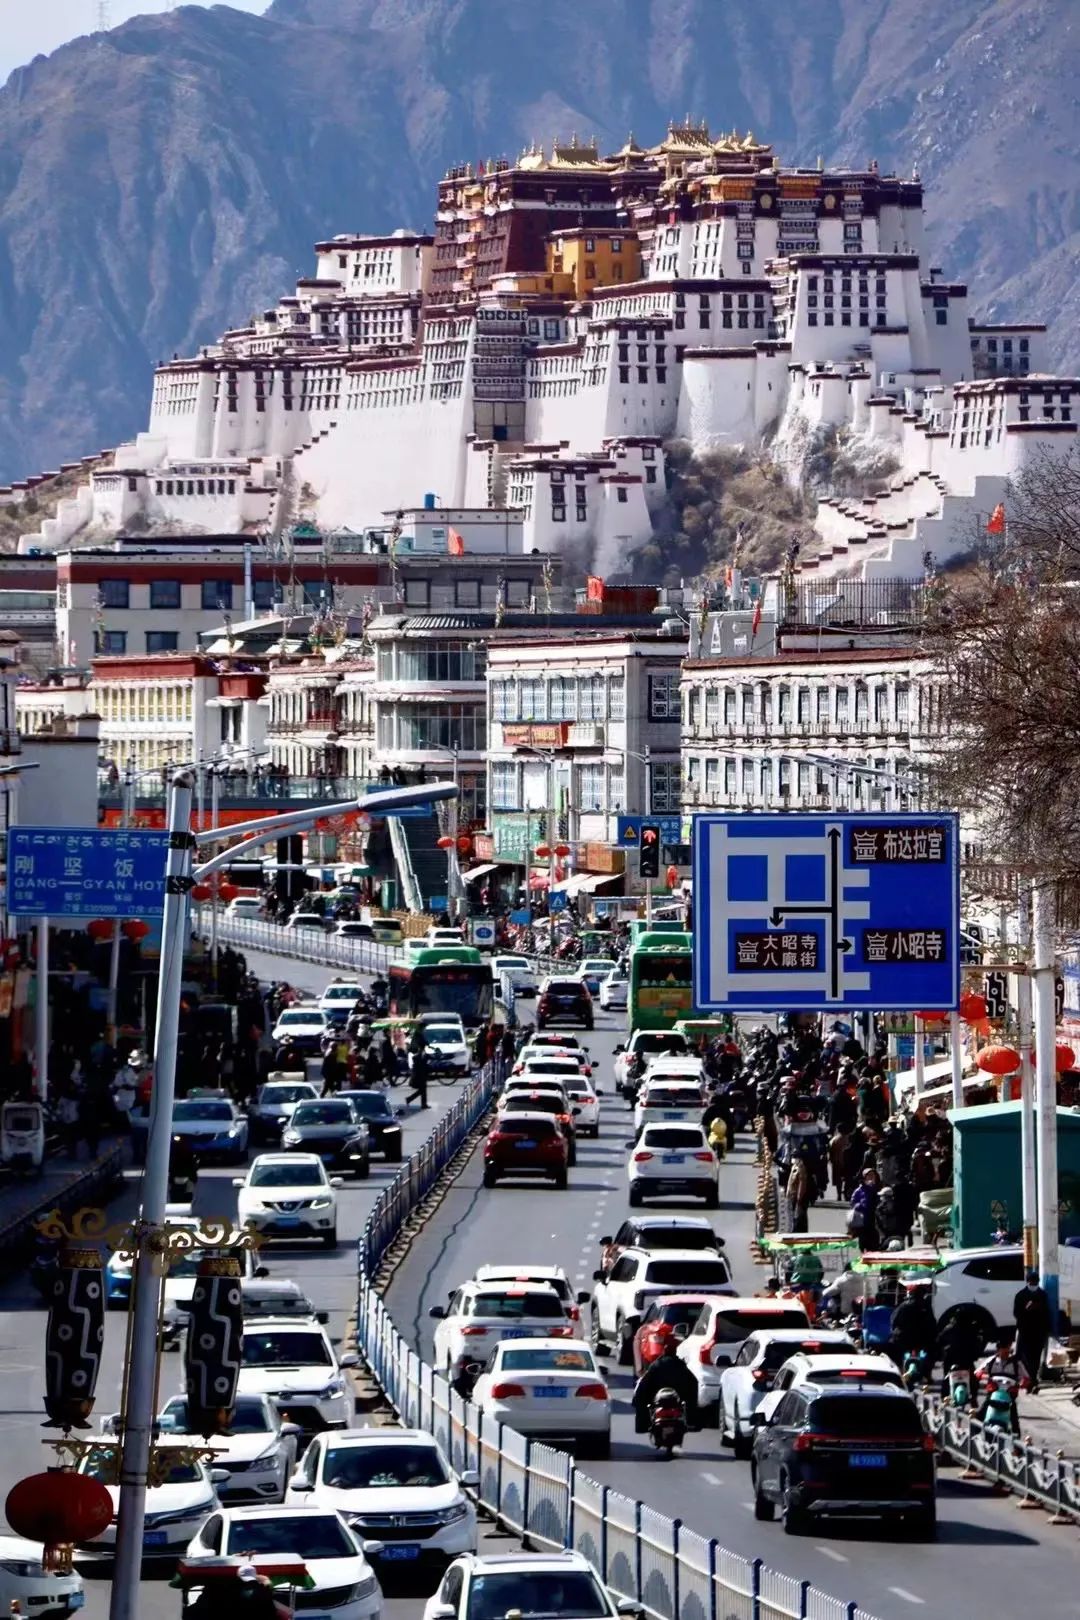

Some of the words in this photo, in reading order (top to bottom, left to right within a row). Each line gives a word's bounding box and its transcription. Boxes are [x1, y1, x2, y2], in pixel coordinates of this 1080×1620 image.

[883, 830, 942, 860] 布达拉宫
[763, 934, 816, 950] 大昭寺
[891, 931, 942, 960] 小昭寺
